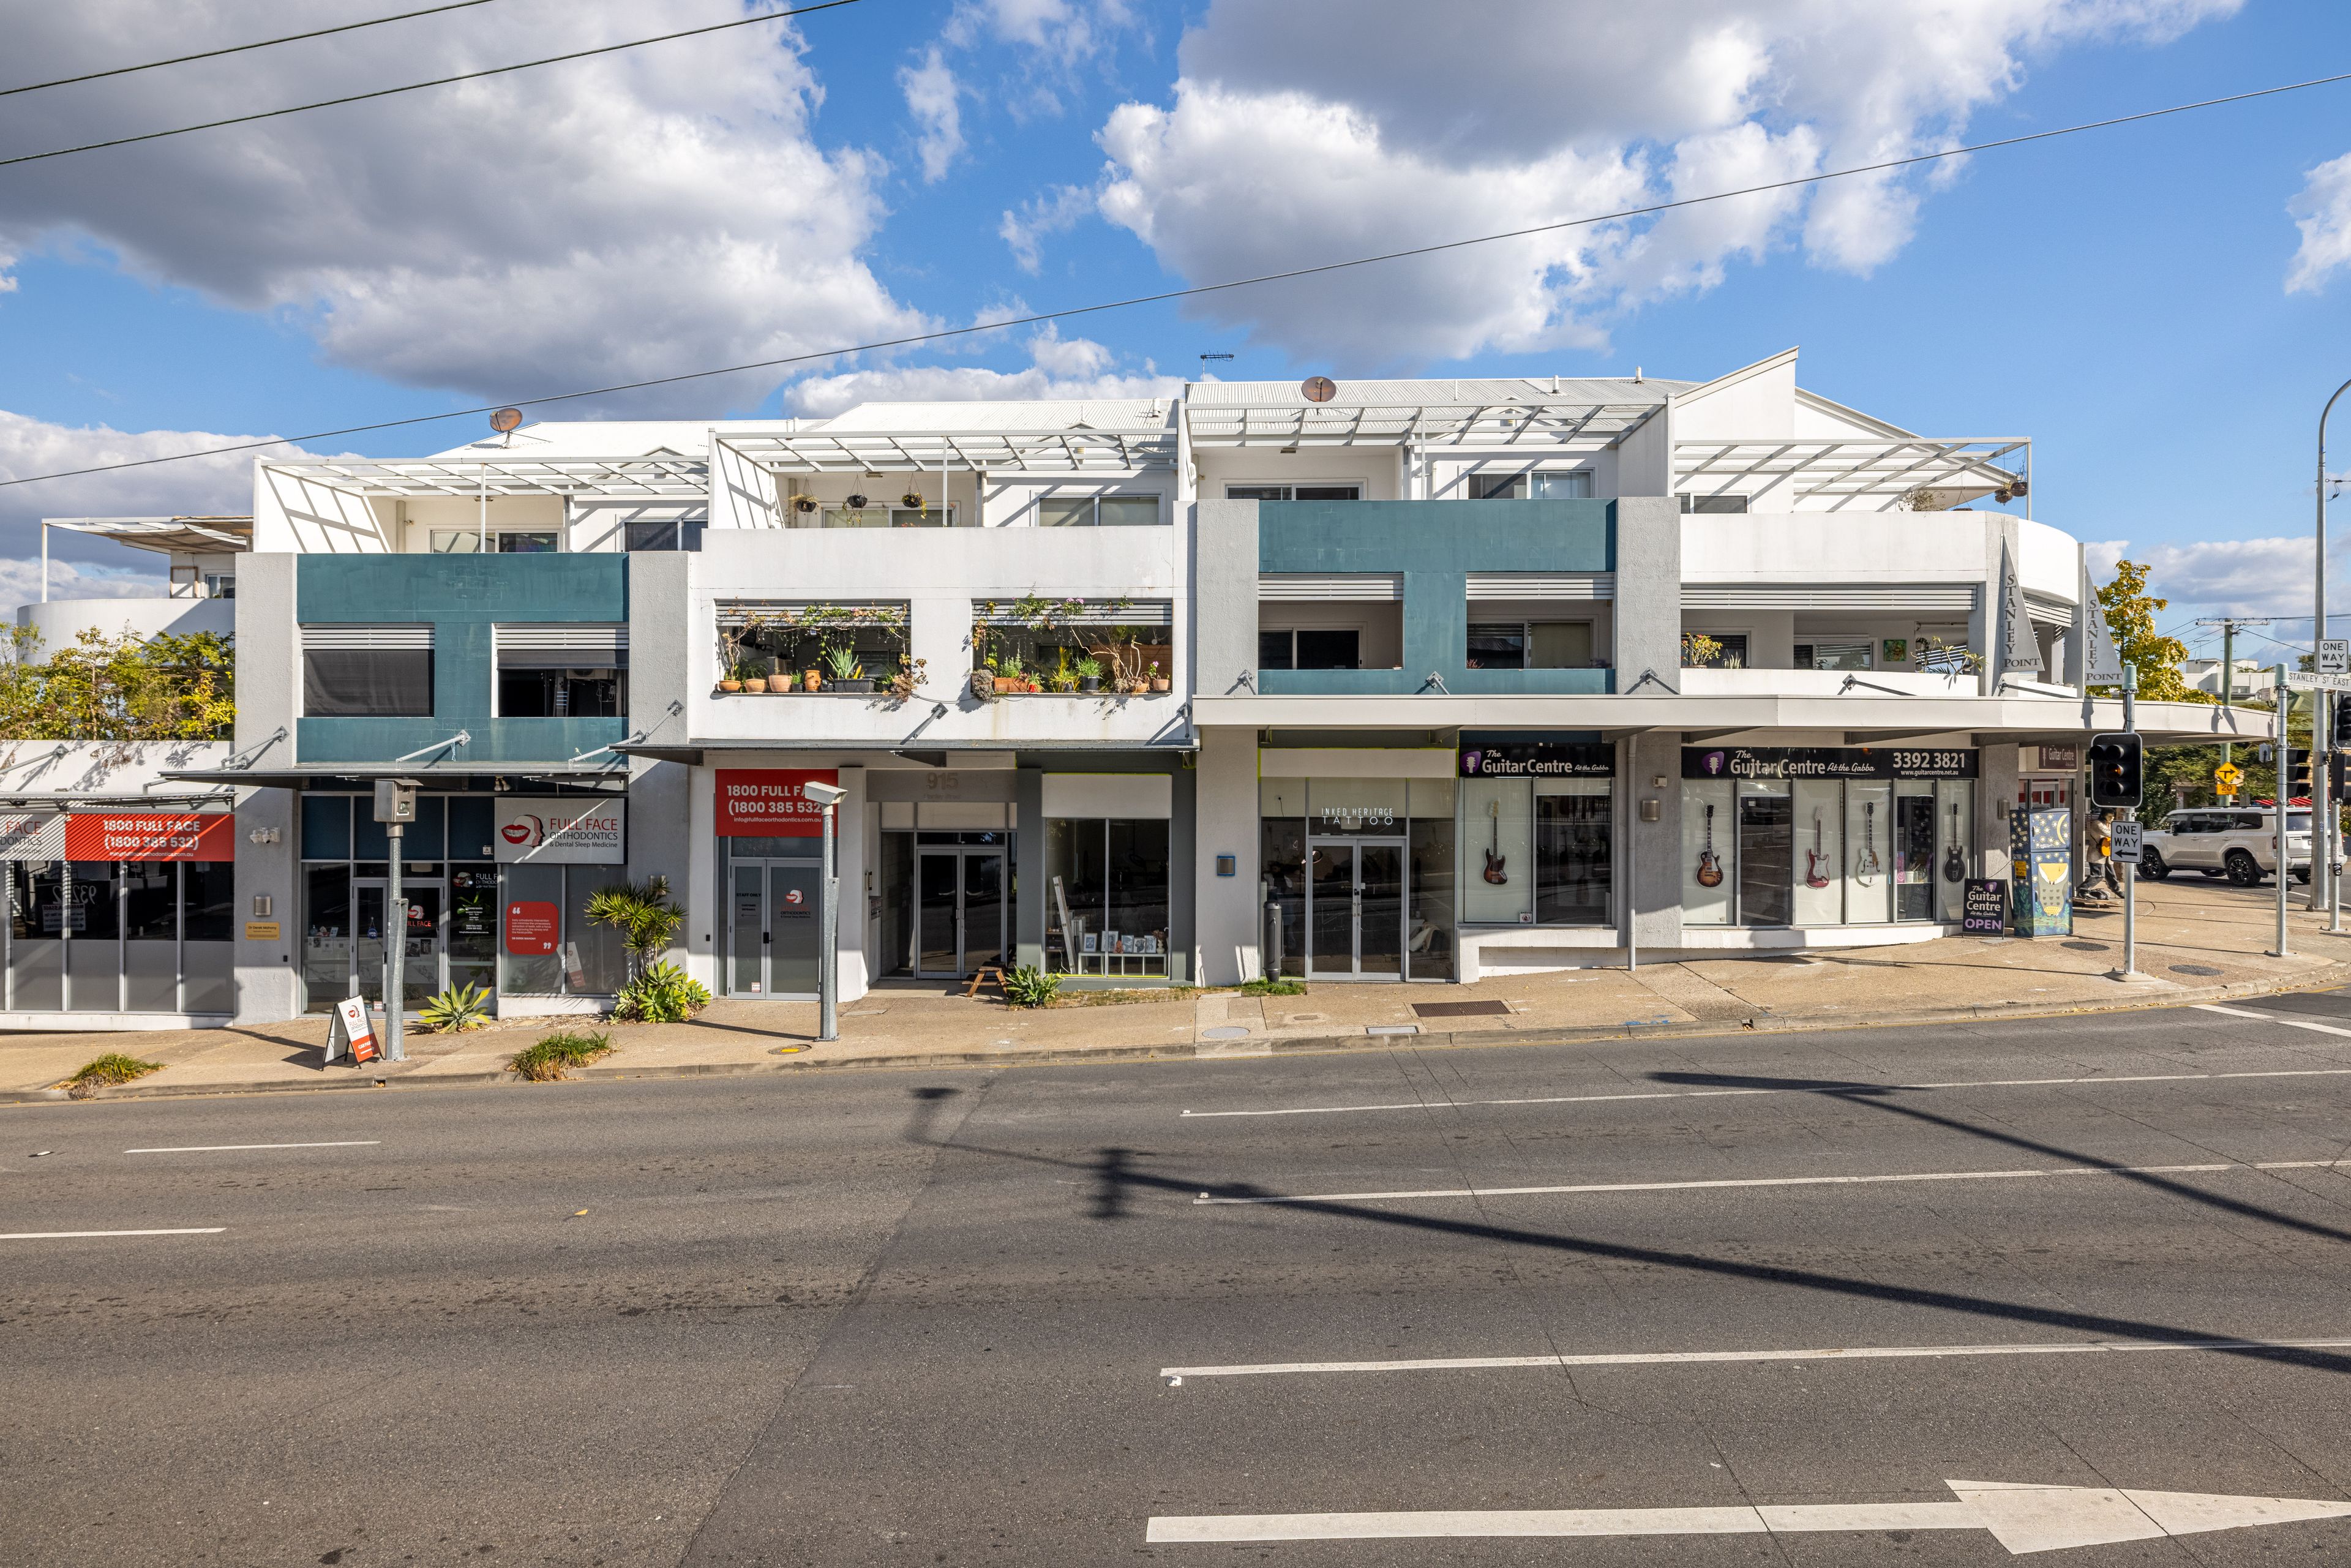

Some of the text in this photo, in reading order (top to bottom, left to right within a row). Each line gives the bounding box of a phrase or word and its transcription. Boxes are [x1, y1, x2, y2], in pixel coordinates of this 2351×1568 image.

[2004, 574, 2017, 654] STANLEY
[2087, 599, 2099, 669] STANLEY
[2003, 658, 2040, 667] POINT
[2289, 673, 2319, 683] STANLEY
[2333, 678, 2349, 686] EAST
[1735, 750, 1752, 759] The
[1892, 752, 1965, 768] 3392 3821
[1482, 759, 1573, 773] Guitar Centre
[1730, 759, 1826, 774] Guitar Centre
[1851, 763, 1875, 771] Gabba
[926, 772, 959, 790] 915
[727, 785, 758, 797] 1800
[761, 786, 791, 797] FULL
[729, 800, 821, 816] (1800 385 532
[1321, 808, 1393, 816] INKED HERITAGE
[103, 820, 200, 831] 1800 FULL FACE
[550, 818, 618, 830] FULL FACE
[1322, 816, 1393, 825] TATTOO
[6, 821, 42, 834] FACE
[2116, 825, 2137, 835] ONE
[104, 834, 199, 850] (1800 385 532)
[2114, 837, 2138, 847] WAY
[1968, 891, 2002, 901] Guitar
[1967, 901, 2001, 911] Centre
[1965, 918, 2002, 930] OPEN
